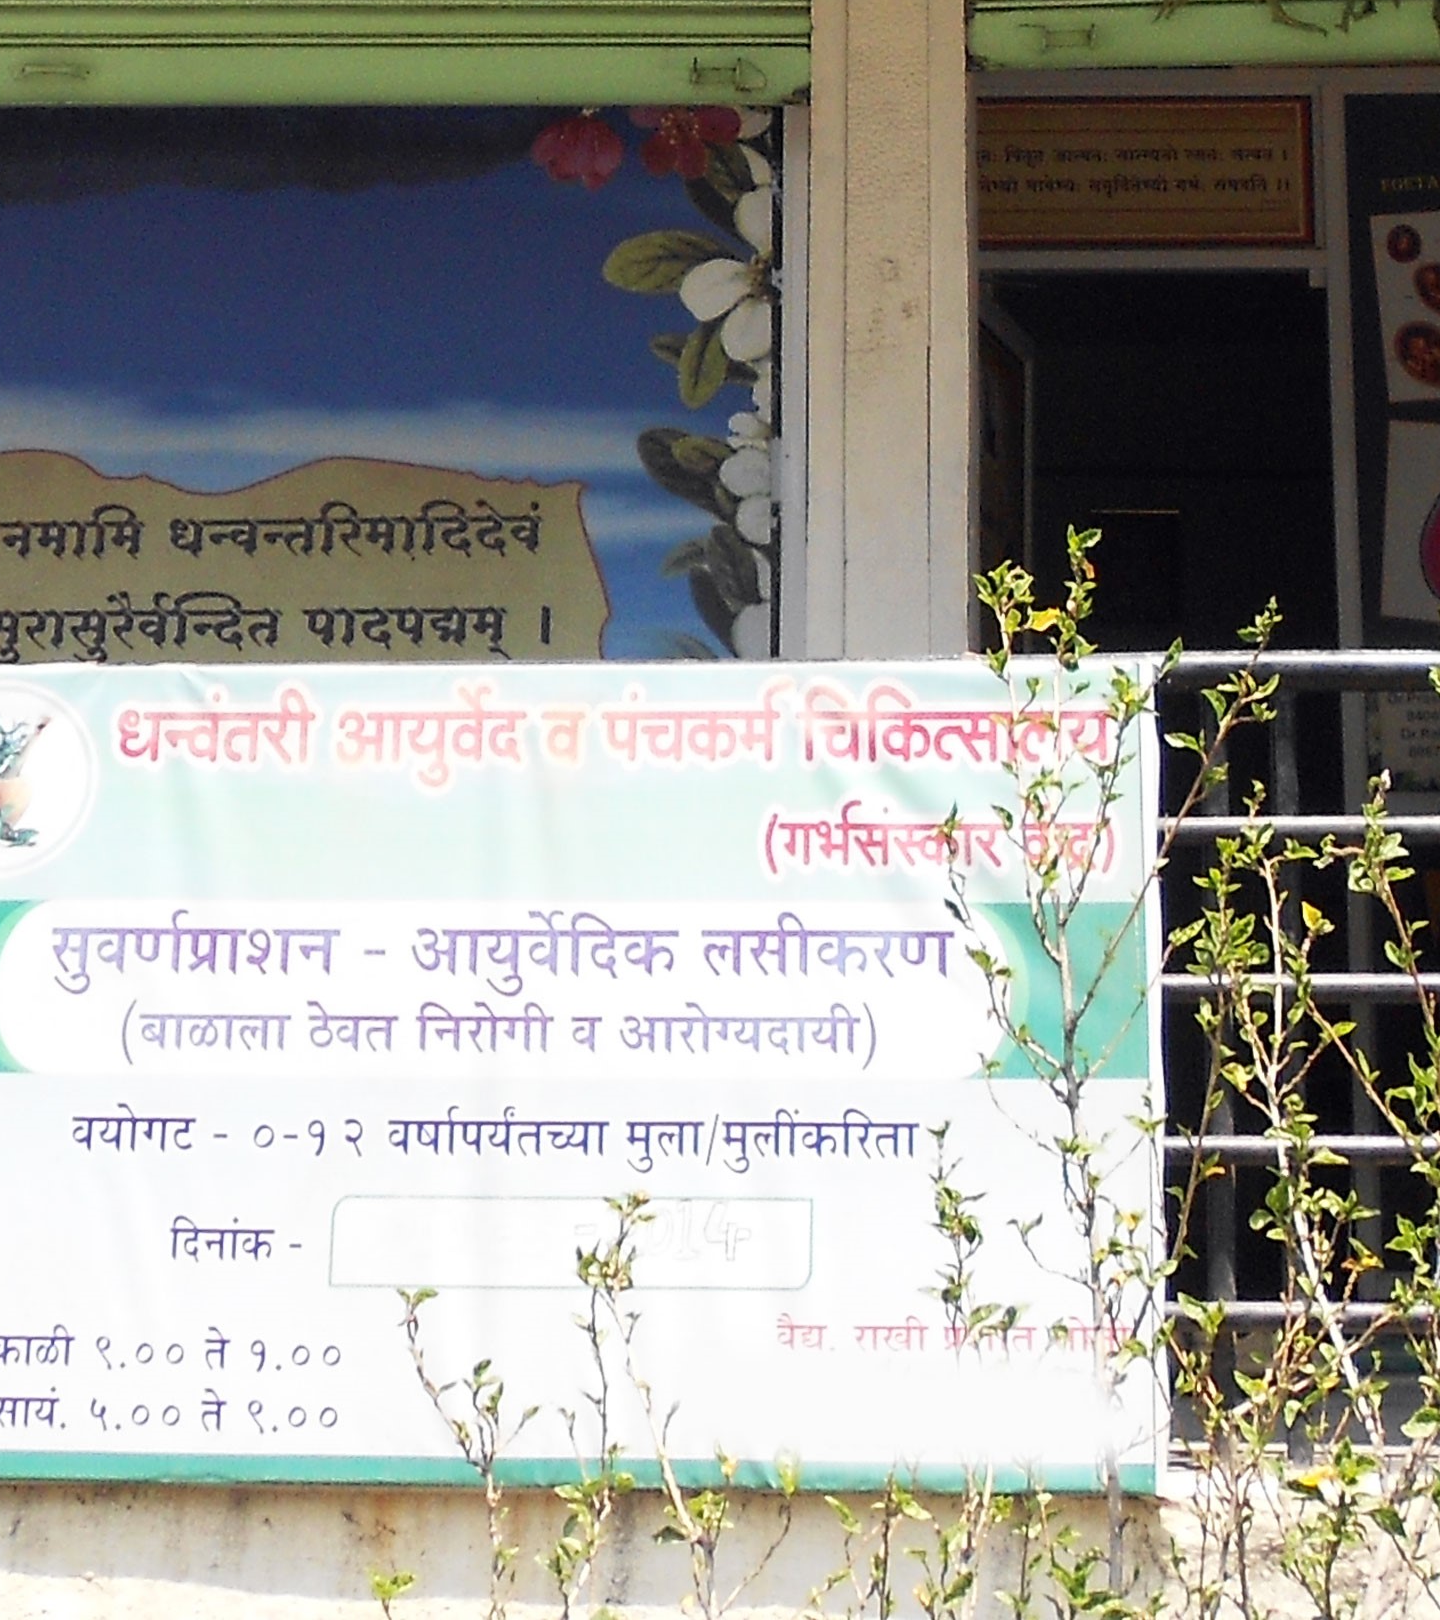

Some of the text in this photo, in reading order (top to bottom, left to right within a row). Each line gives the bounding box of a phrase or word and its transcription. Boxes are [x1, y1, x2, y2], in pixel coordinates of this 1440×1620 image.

[170, 498, 542, 560] धन्वन्तरिमादिदेवं
[304, 605, 509, 659] पादपद्मम्
[116, 682, 1116, 784] धन्वंतरी आयुर्वेद व पंचकर्म चिकित्सालय
[766, 800, 1005, 875] (गर्भसंस्कार
[52, 913, 337, 995] सुवर्णप्राशन
[413, 911, 679, 996] आयुर्वेदिक
[701, 916, 956, 978] लसीकरण
[120, 997, 879, 1068] (बाळाला ठेवत निरोगी व आरोग्यदायी)
[71, 1103, 198, 1154] वयोगट
[388, 1101, 605, 1160] वर्षापर्यंतच्या
[625, 1101, 922, 1170] मुला/मुलींकरिता
[170, 1215, 276, 1263] दिनांक
[204, 1327, 231, 1368] ते
[853, 1314, 929, 1352] राखी
[202, 1389, 226, 1431] ते
